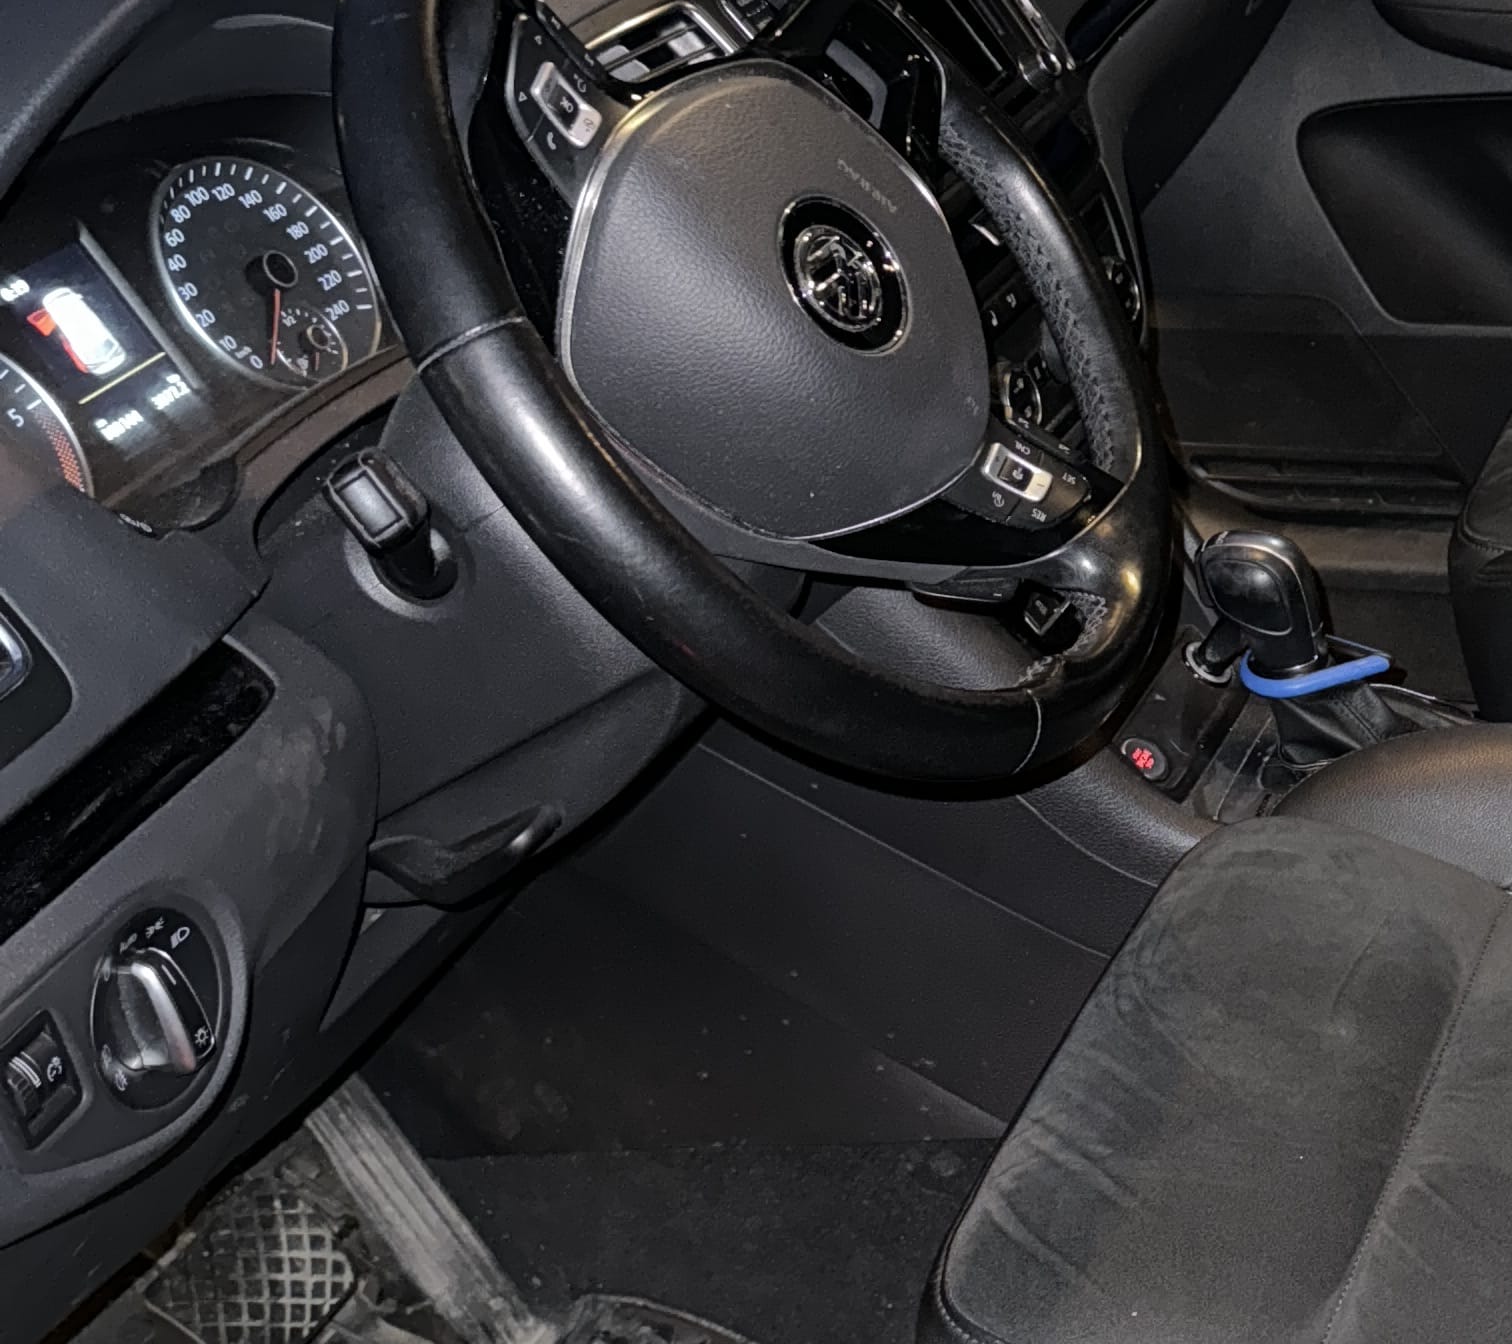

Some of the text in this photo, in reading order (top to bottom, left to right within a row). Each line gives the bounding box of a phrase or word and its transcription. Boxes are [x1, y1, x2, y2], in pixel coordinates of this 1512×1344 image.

[184, 185, 211, 207] 100
[211, 182, 236, 203] 120
[237, 189, 264, 209] 140
[169, 204, 192, 224] 80
[262, 203, 288, 223] 160
[163, 228, 186, 249] 60
[286, 221, 310, 241] 180
[167, 253, 188, 273] 40
[304, 243, 329, 264] 200
[317, 269, 343, 292] 220
[178, 282, 199, 301] 30
[196, 309, 216, 328] 20
[324, 299, 350, 322] 240
[219, 334, 238, 352] 10
[250, 355, 264, 370] 0
[7, 407, 25, 428] 5
